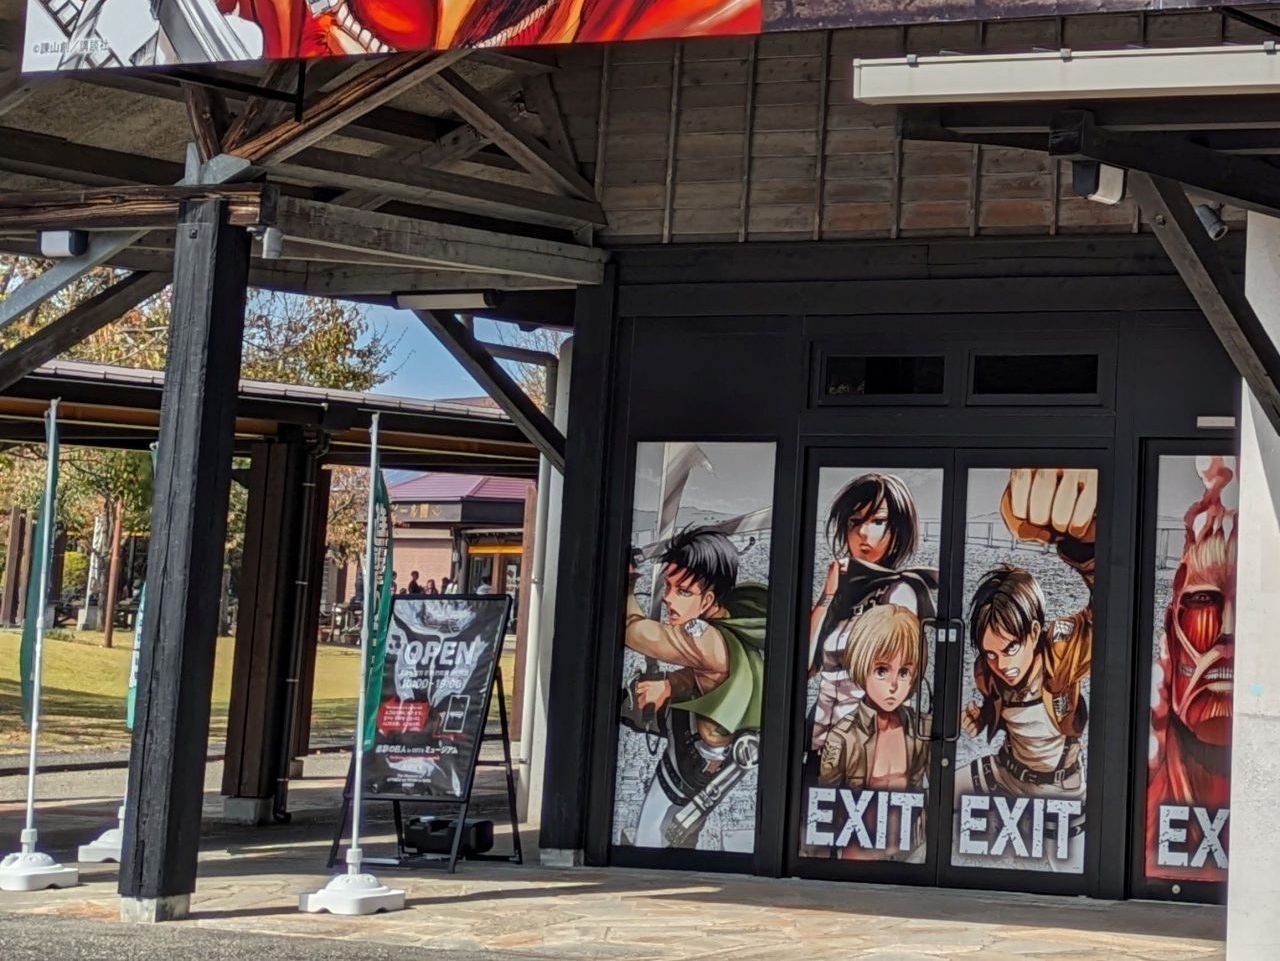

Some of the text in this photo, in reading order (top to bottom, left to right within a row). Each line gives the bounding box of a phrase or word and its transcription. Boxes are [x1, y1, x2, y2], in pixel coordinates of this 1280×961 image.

[404, 641, 475, 666] OPEN
[805, 786, 924, 851] EXIT
[959, 795, 1082, 859] EXIT
